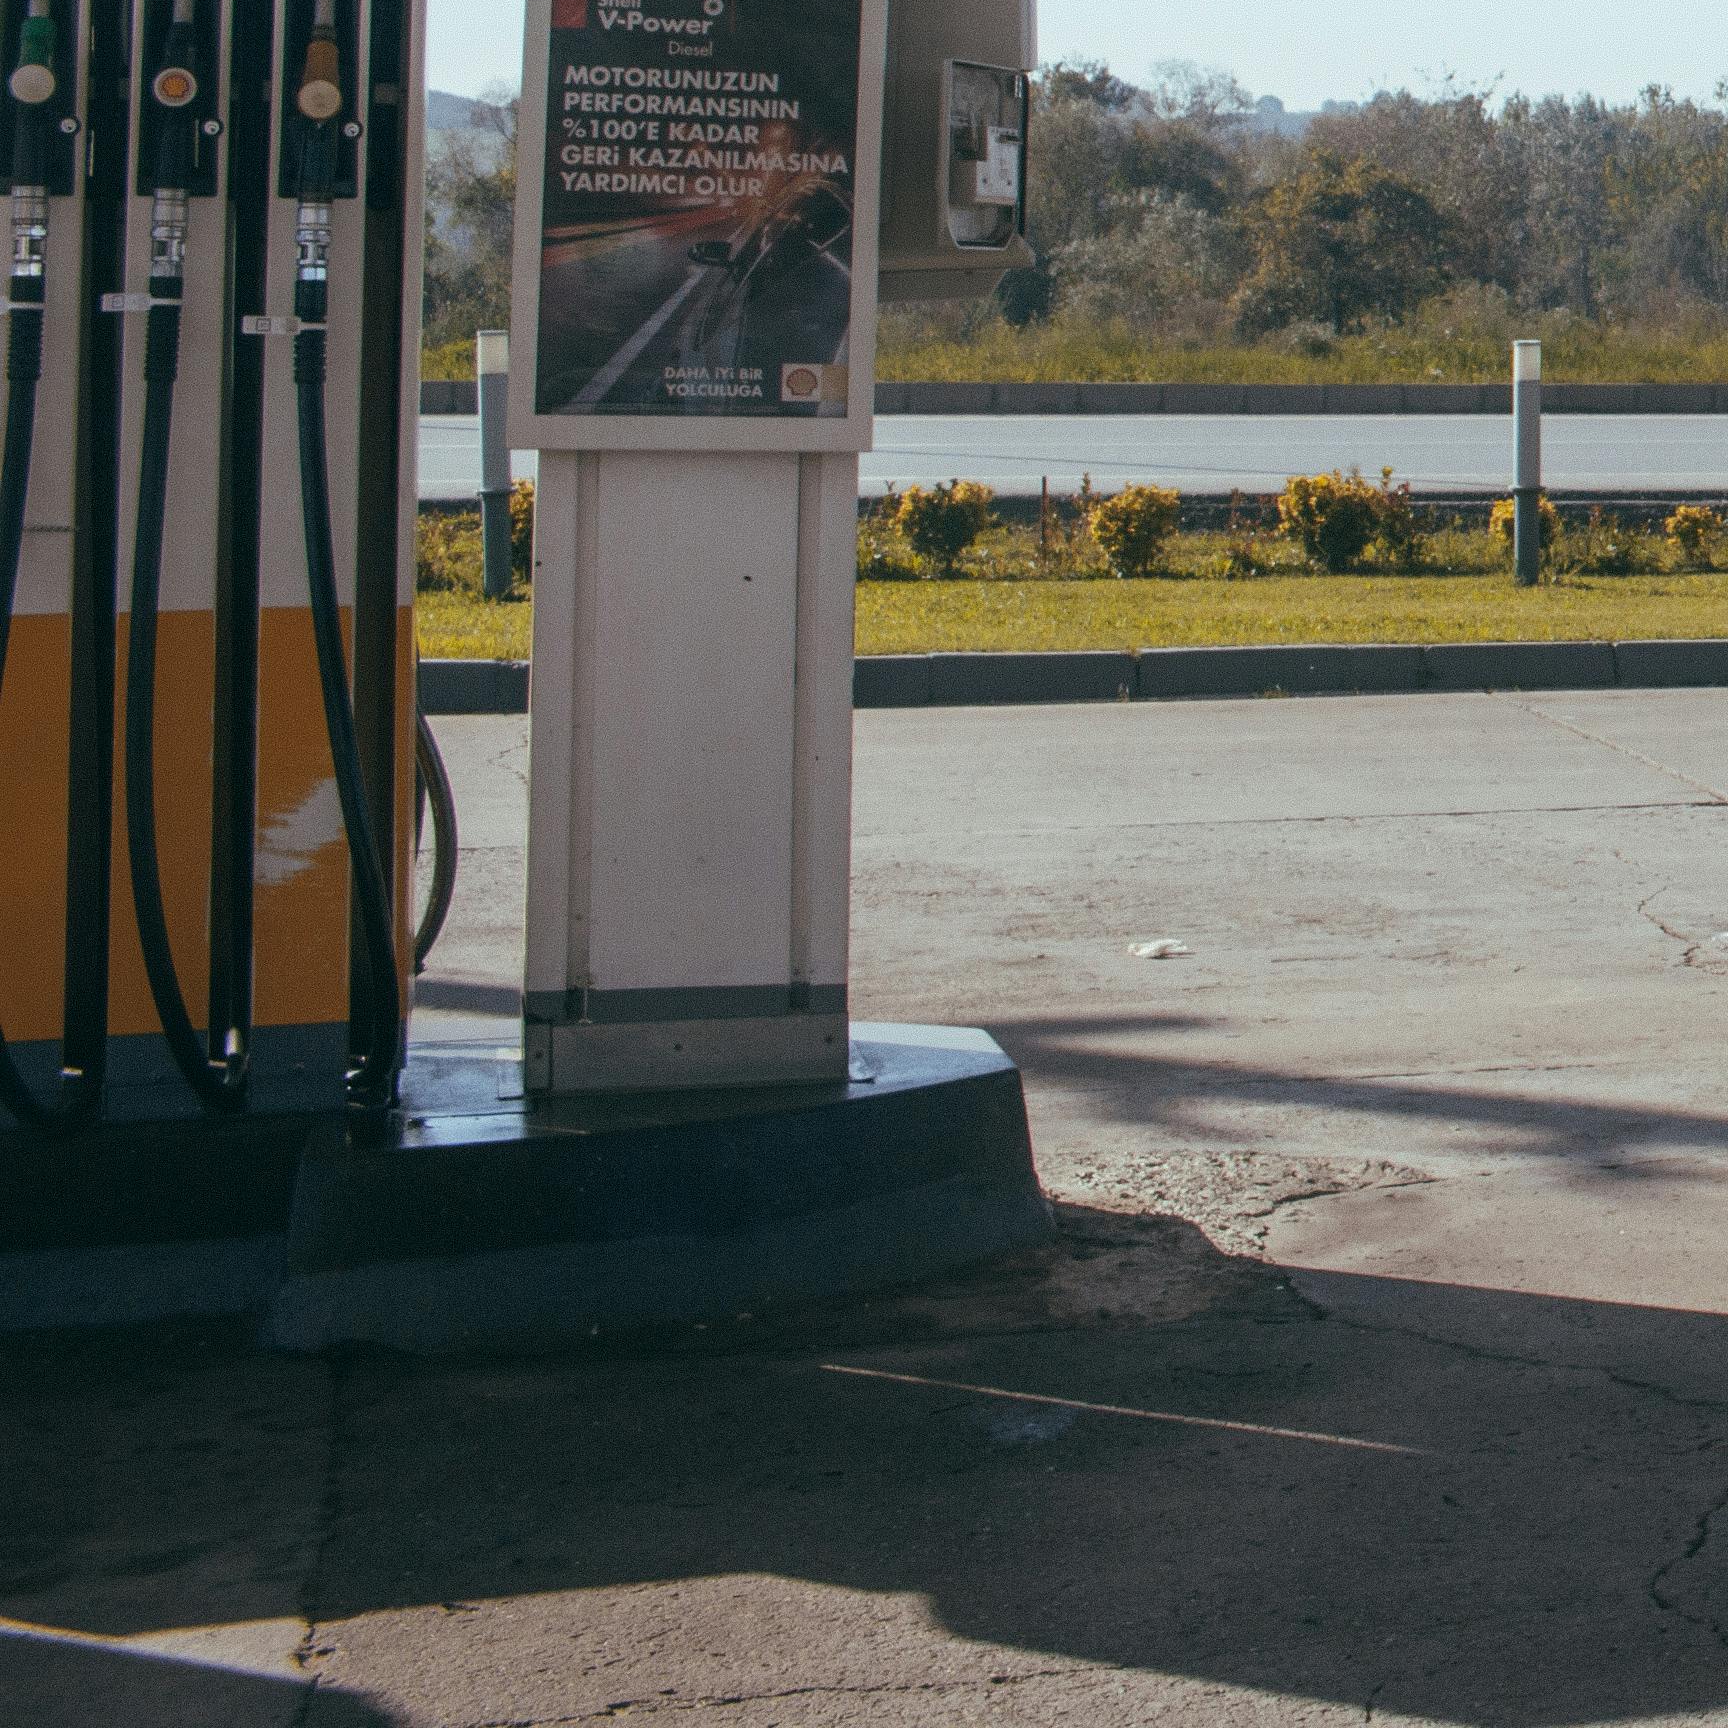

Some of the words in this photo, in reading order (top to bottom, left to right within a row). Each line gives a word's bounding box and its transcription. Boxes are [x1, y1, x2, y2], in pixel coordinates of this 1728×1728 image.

[597, 10, 714, 35] V-Power
[667, 40, 714, 57] Diesel
[563, 65, 779, 93] MOTORUNUZUN
[563, 91, 799, 120] PERFORMANSININ
[669, 122, 760, 144] KADAR
[629, 147, 848, 174] KAZANILMASINA
[560, 170, 686, 195] YARDIMCI
[694, 175, 764, 198] OLUR
[664, 366, 710, 380] DAHA
